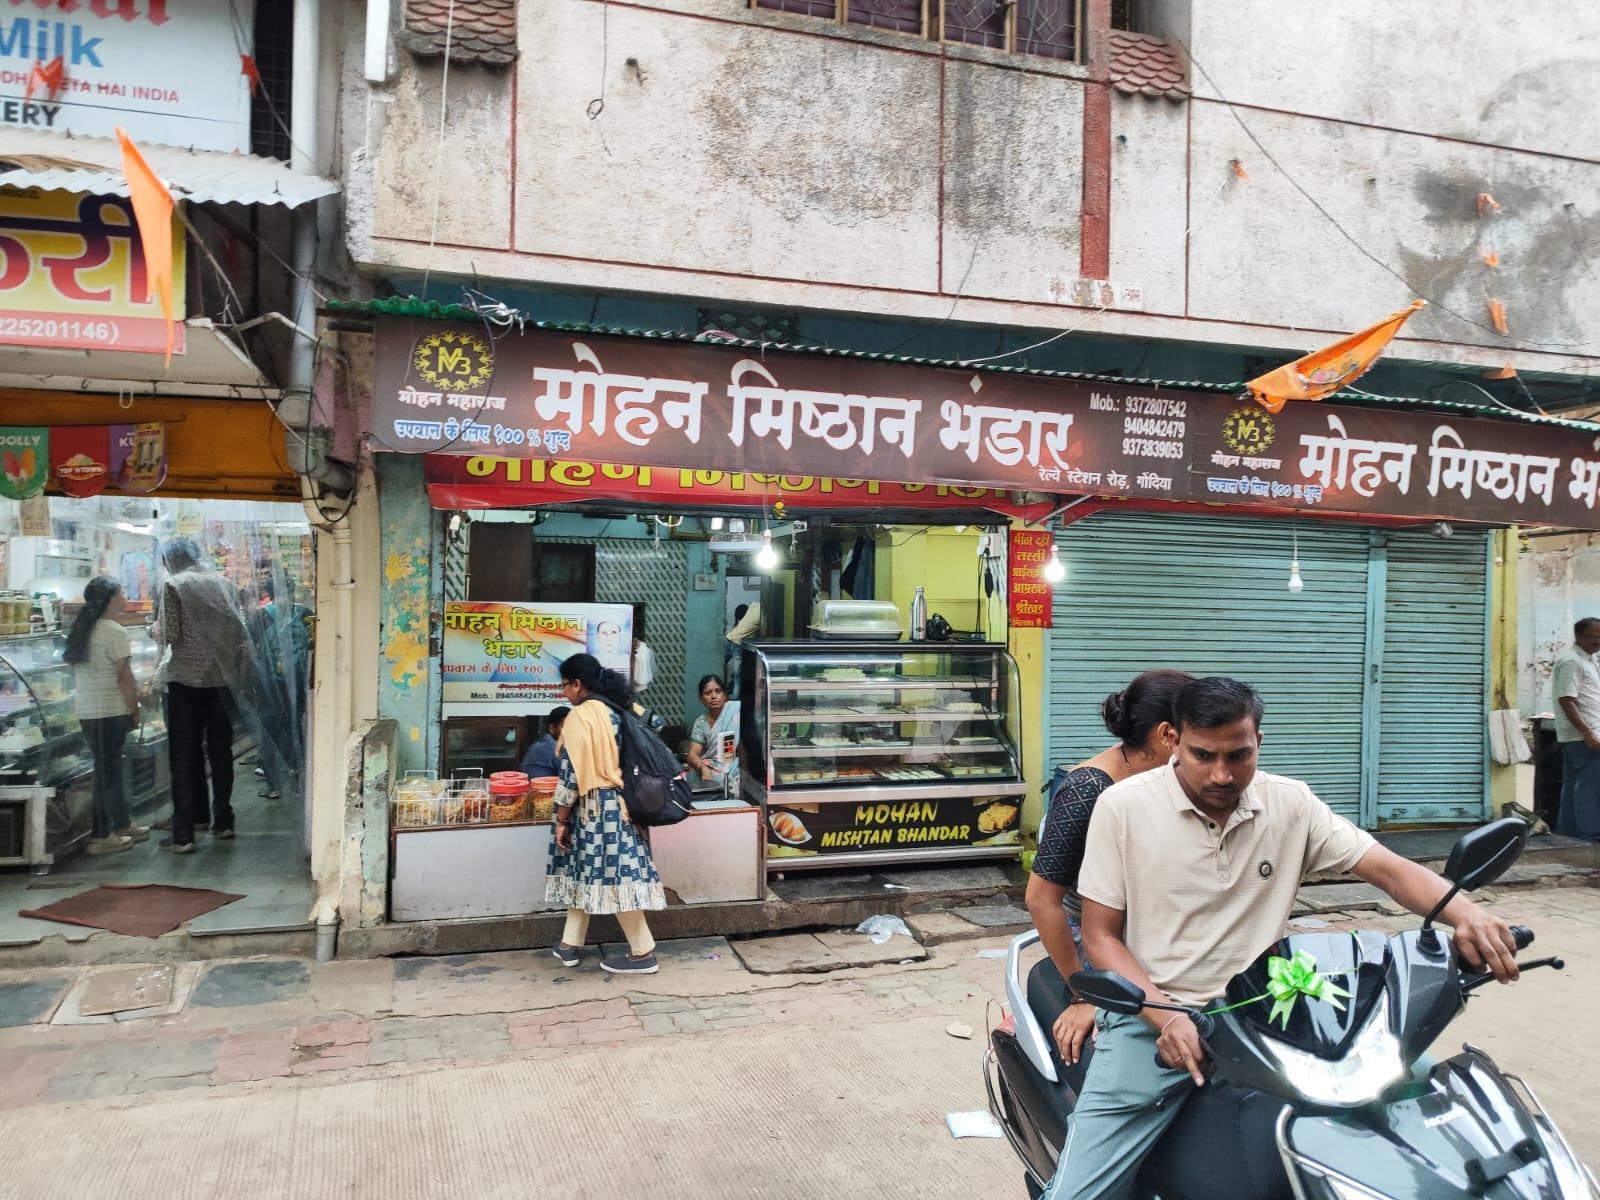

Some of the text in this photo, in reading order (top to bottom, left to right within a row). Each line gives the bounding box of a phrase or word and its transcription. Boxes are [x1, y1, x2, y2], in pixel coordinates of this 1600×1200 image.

[98, 83, 127, 97] HAI
[132, 86, 179, 103] INDIA
[0, 101, 62, 127] ERY
[0, 317, 119, 345] 25201146)
[398, 386, 506, 410] मोहन महाराज
[533, 342, 1074, 469] मोहन मिष्ठान भंडार
[1125, 395, 1187, 418] 9372807542
[394, 419, 442, 440] उपवास
[443, 416, 460, 441] के
[461, 418, 491, 444] लिए
[1124, 416, 1186, 439] 9404842479
[1122, 437, 1184, 460] 9373839053
[1211, 450, 1282, 470] मोहन महाराज
[1299, 414, 1418, 497] मोहन
[1427, 425, 1560, 506] मिष्ठान
[1066, 467, 1102, 485] स्टेशन
[1136, 471, 1173, 490] गोंदिया
[509, 607, 586, 631] मिष्ठान
[482, 634, 544, 659] भंडार
[855, 800, 939, 826] MOHAN
[820, 824, 970, 847] MISHTAN BHANDAR
